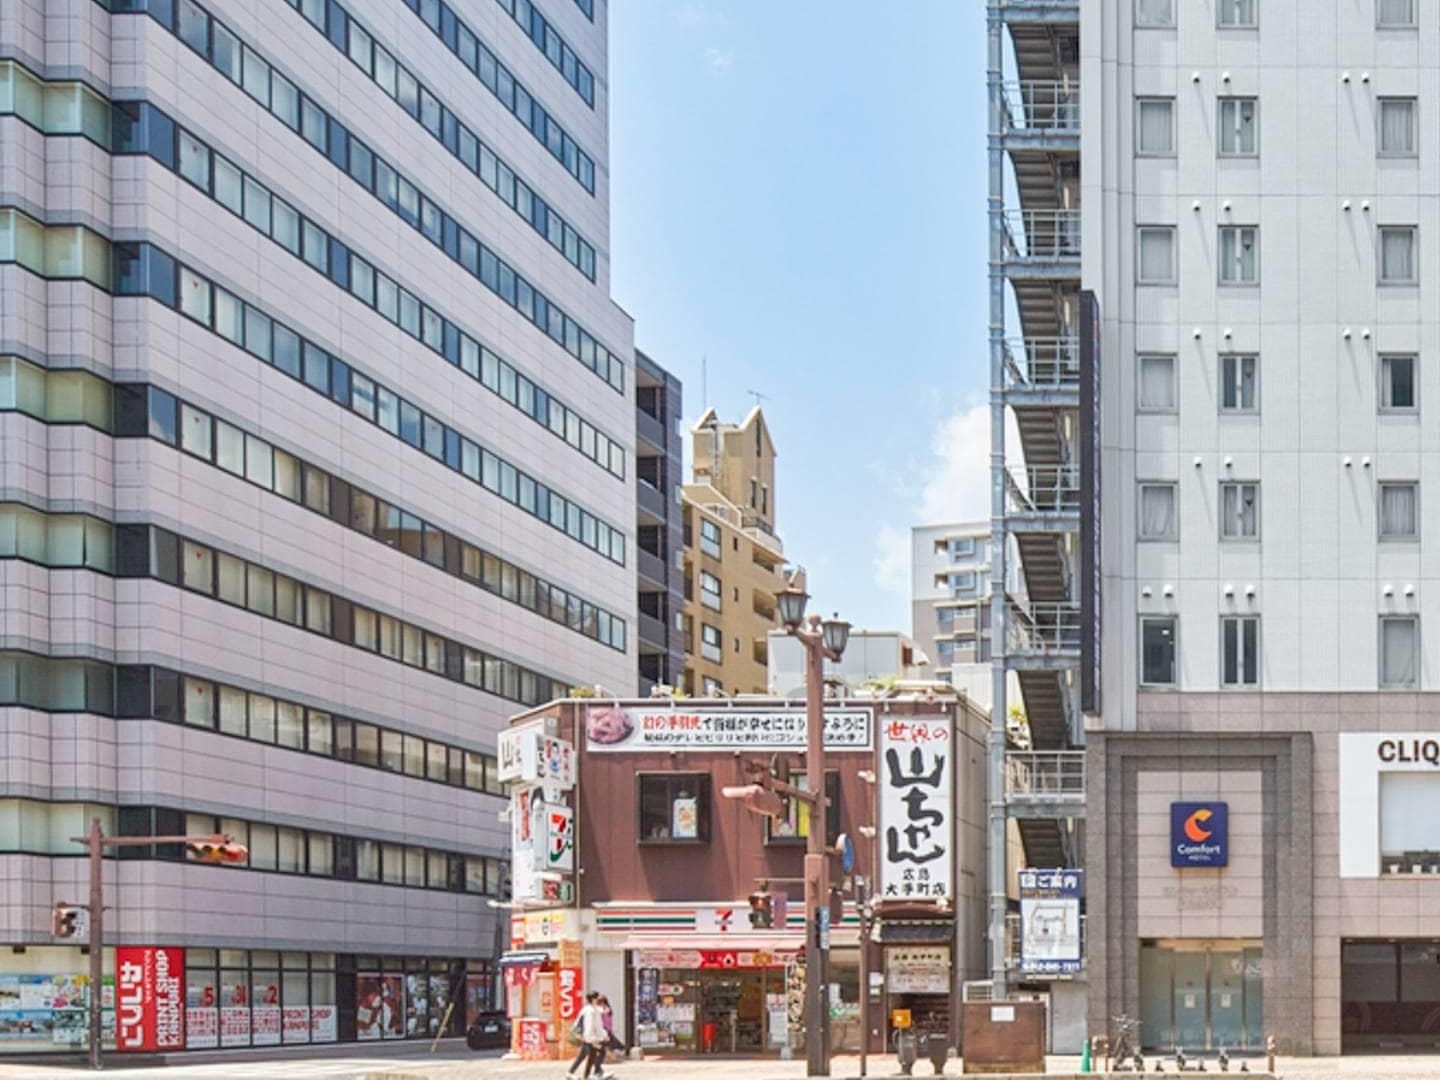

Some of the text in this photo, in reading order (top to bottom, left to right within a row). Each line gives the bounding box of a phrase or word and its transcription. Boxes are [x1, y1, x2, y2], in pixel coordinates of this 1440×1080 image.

[885, 746, 945, 864] 山ちゃん
[1177, 844, 1221, 855] Comfort
[155, 950, 169, 993] SHOP
